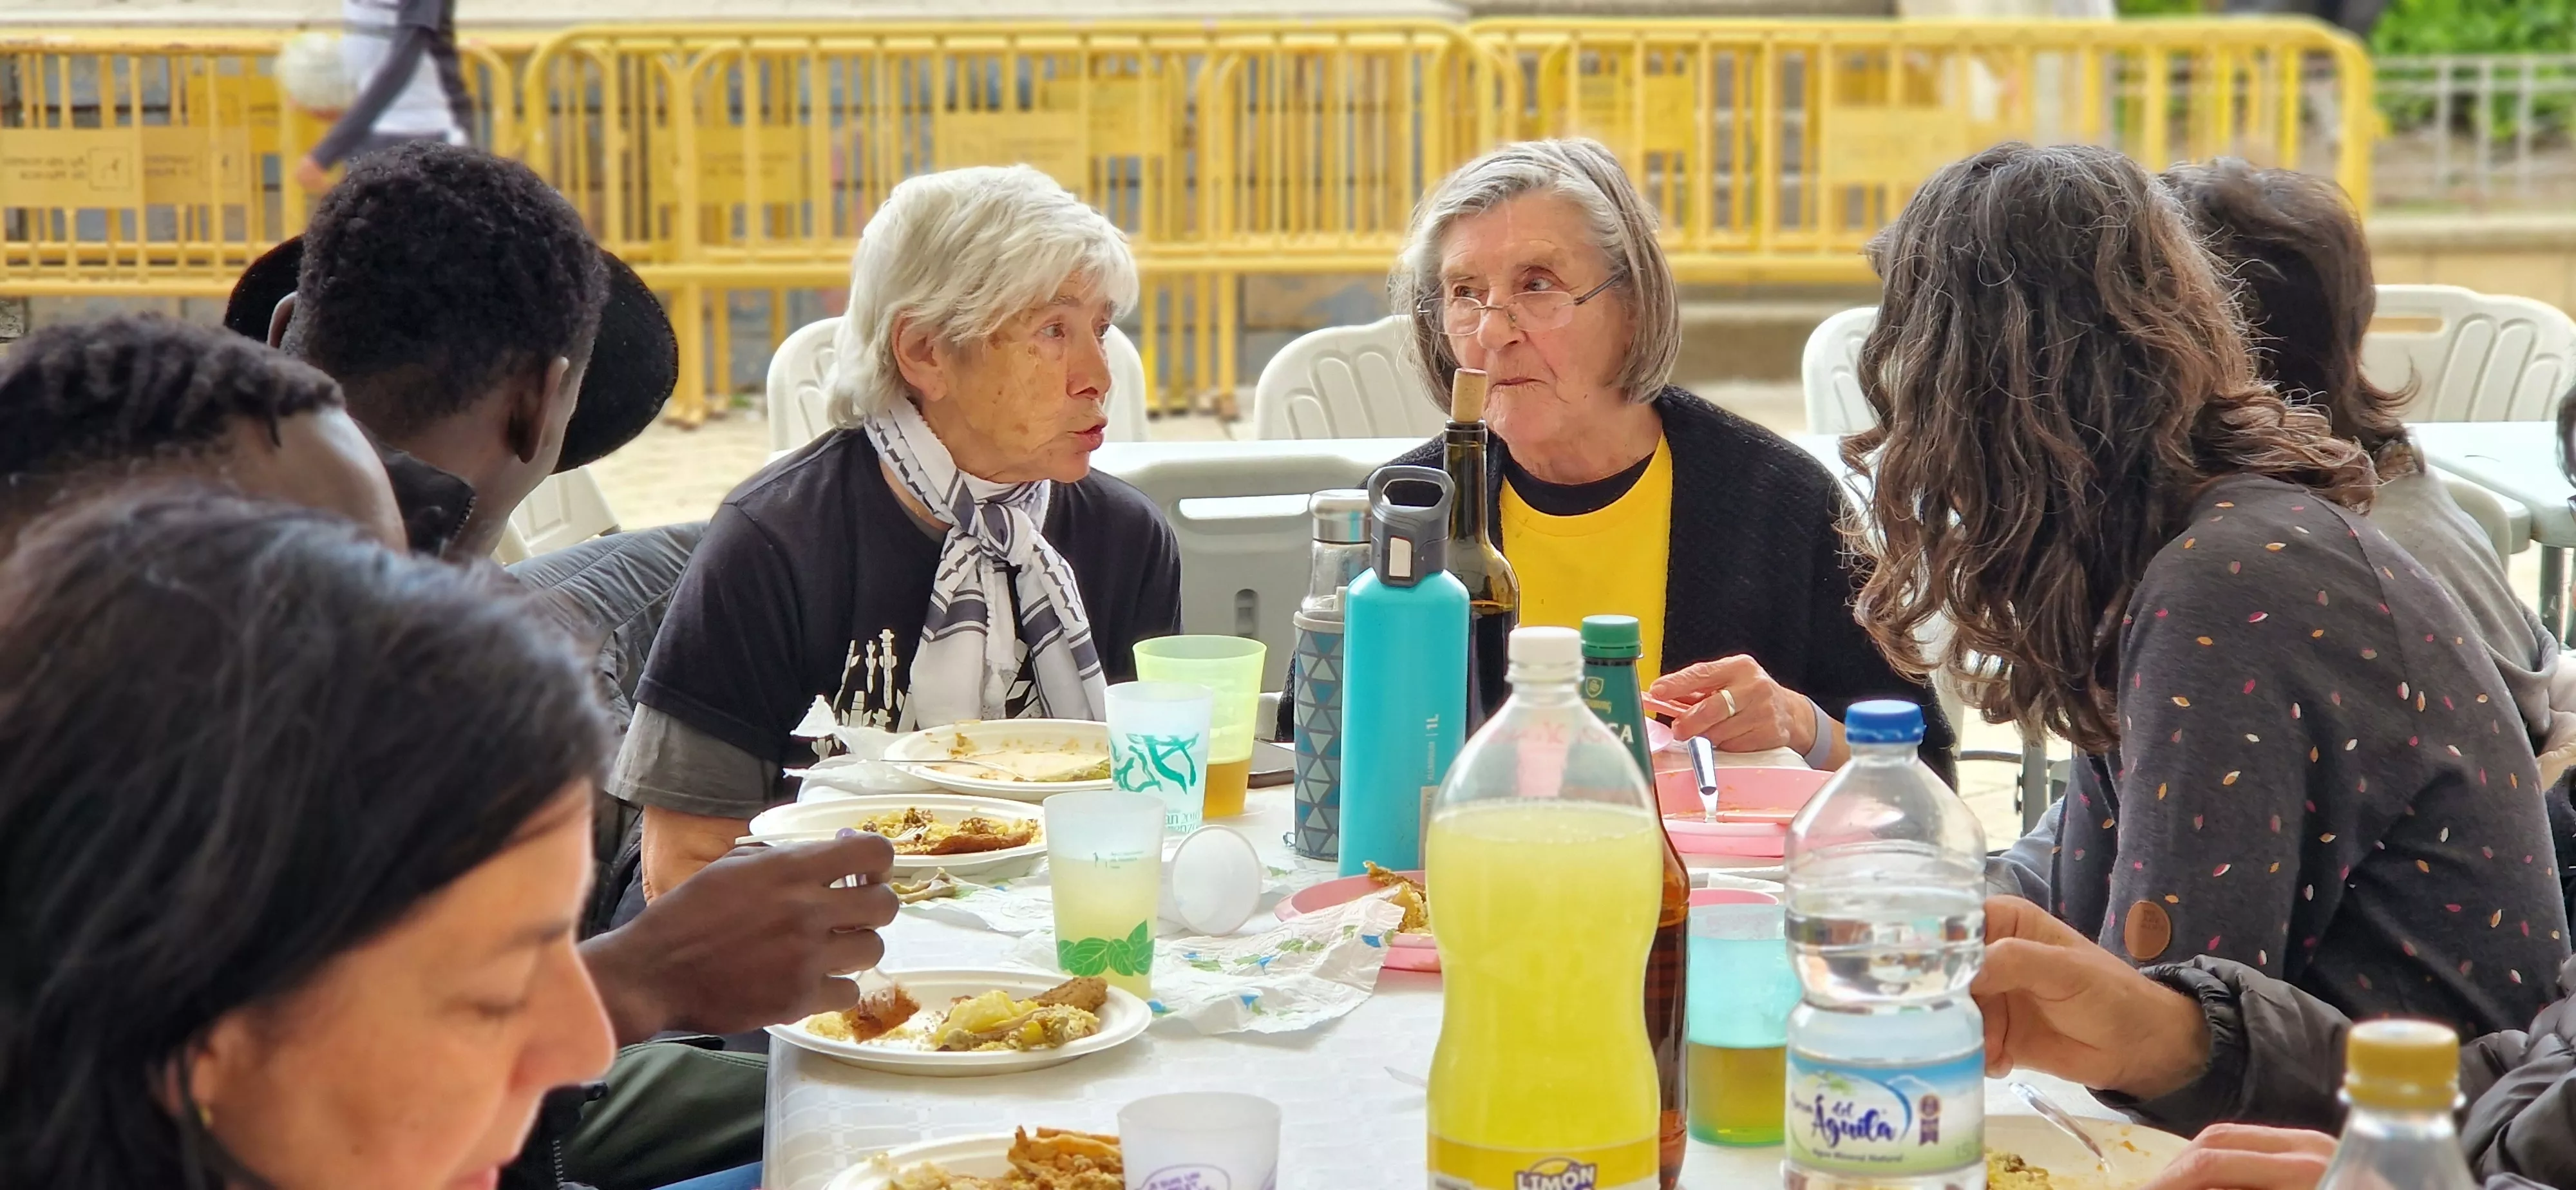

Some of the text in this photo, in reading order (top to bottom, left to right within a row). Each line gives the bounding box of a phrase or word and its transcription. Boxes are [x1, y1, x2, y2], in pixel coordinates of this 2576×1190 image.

[1426, 713, 1439, 730] 1L
[1164, 814, 1179, 825] an
[1812, 1094, 1896, 1148] Águila
